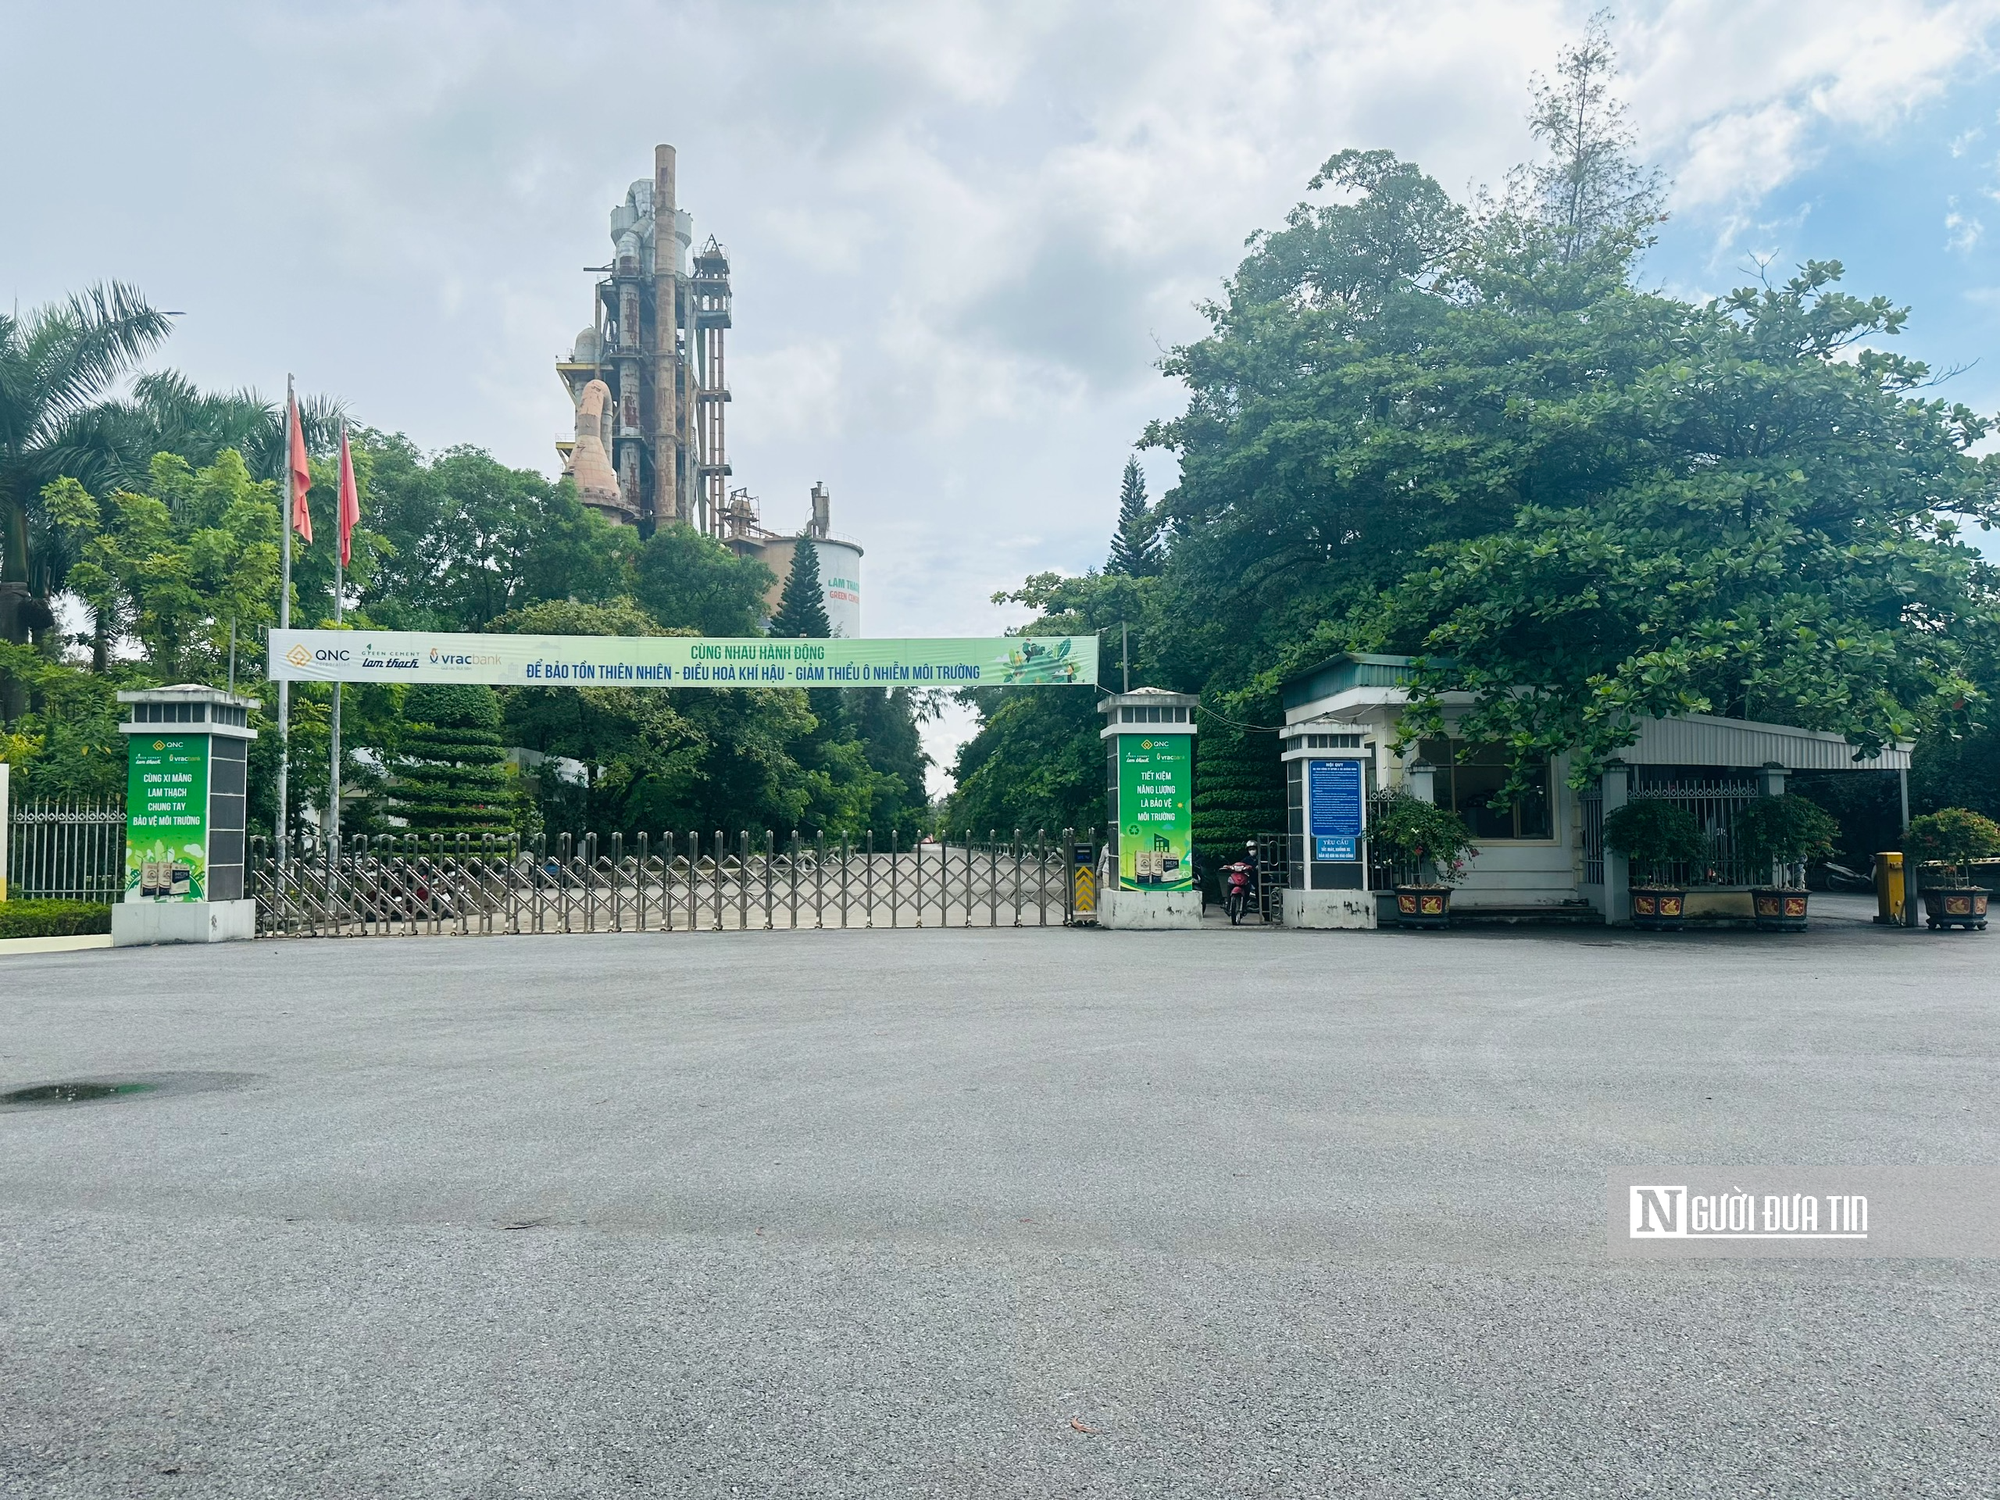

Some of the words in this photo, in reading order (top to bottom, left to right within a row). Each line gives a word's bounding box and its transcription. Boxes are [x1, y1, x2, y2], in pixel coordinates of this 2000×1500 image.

[828, 578, 845, 588] LAM
[830, 590, 848, 600] GREEN
[316, 650, 350, 660] QNC
[691, 643, 722, 660] CÙNG
[724, 646, 756, 660] NHAU
[760, 644, 791, 660] HÀNH
[794, 644, 824, 662] ĐỘNG
[441, 653, 502, 666] vracbank
[526, 659, 542, 678] ĐỂ
[545, 660, 568, 679] BẢO
[572, 660, 595, 679] TỒN
[598, 662, 633, 680] THIÊN
[636, 663, 672, 680] NHIÊN
[683, 662, 709, 680] ĐIỀU
[712, 664, 736, 680] HOÀ
[739, 664, 758, 680] KHÍ
[762, 664, 785, 683] HẬU
[796, 662, 824, 680] GIẢM
[827, 661, 860, 680] THIỂU
[863, 664, 870, 680] Ô
[874, 661, 910, 680] NHIỄM
[912, 664, 933, 680] MÔI
[936, 663, 980, 680] TRƯỜNG
[144, 772, 162, 782] CÙNG
[163, 774, 170, 782] XI
[172, 772, 192, 782] MĂNG
[1141, 770, 1154, 780] TIẾT
[1156, 771, 1172, 781] KIỆM
[148, 788, 162, 797] LAM
[164, 788, 187, 798] THẠCH
[1137, 784, 1154, 794] NĂNG
[1156, 786, 1175, 795] LƯỢNG
[148, 802, 171, 811] CHUNG
[172, 802, 186, 811] TAY
[1141, 798, 1148, 807] LÀ
[1150, 797, 1162, 807] BẢO
[1163, 798, 1172, 808] VỆ
[133, 814, 146, 826] BẢO
[148, 815, 157, 827] VỆ
[159, 815, 171, 826] MÔI
[173, 815, 200, 826] TRƯỜNG
[1138, 812, 1149, 821] MÔI
[1151, 812, 1175, 821] TRƯỜNG
